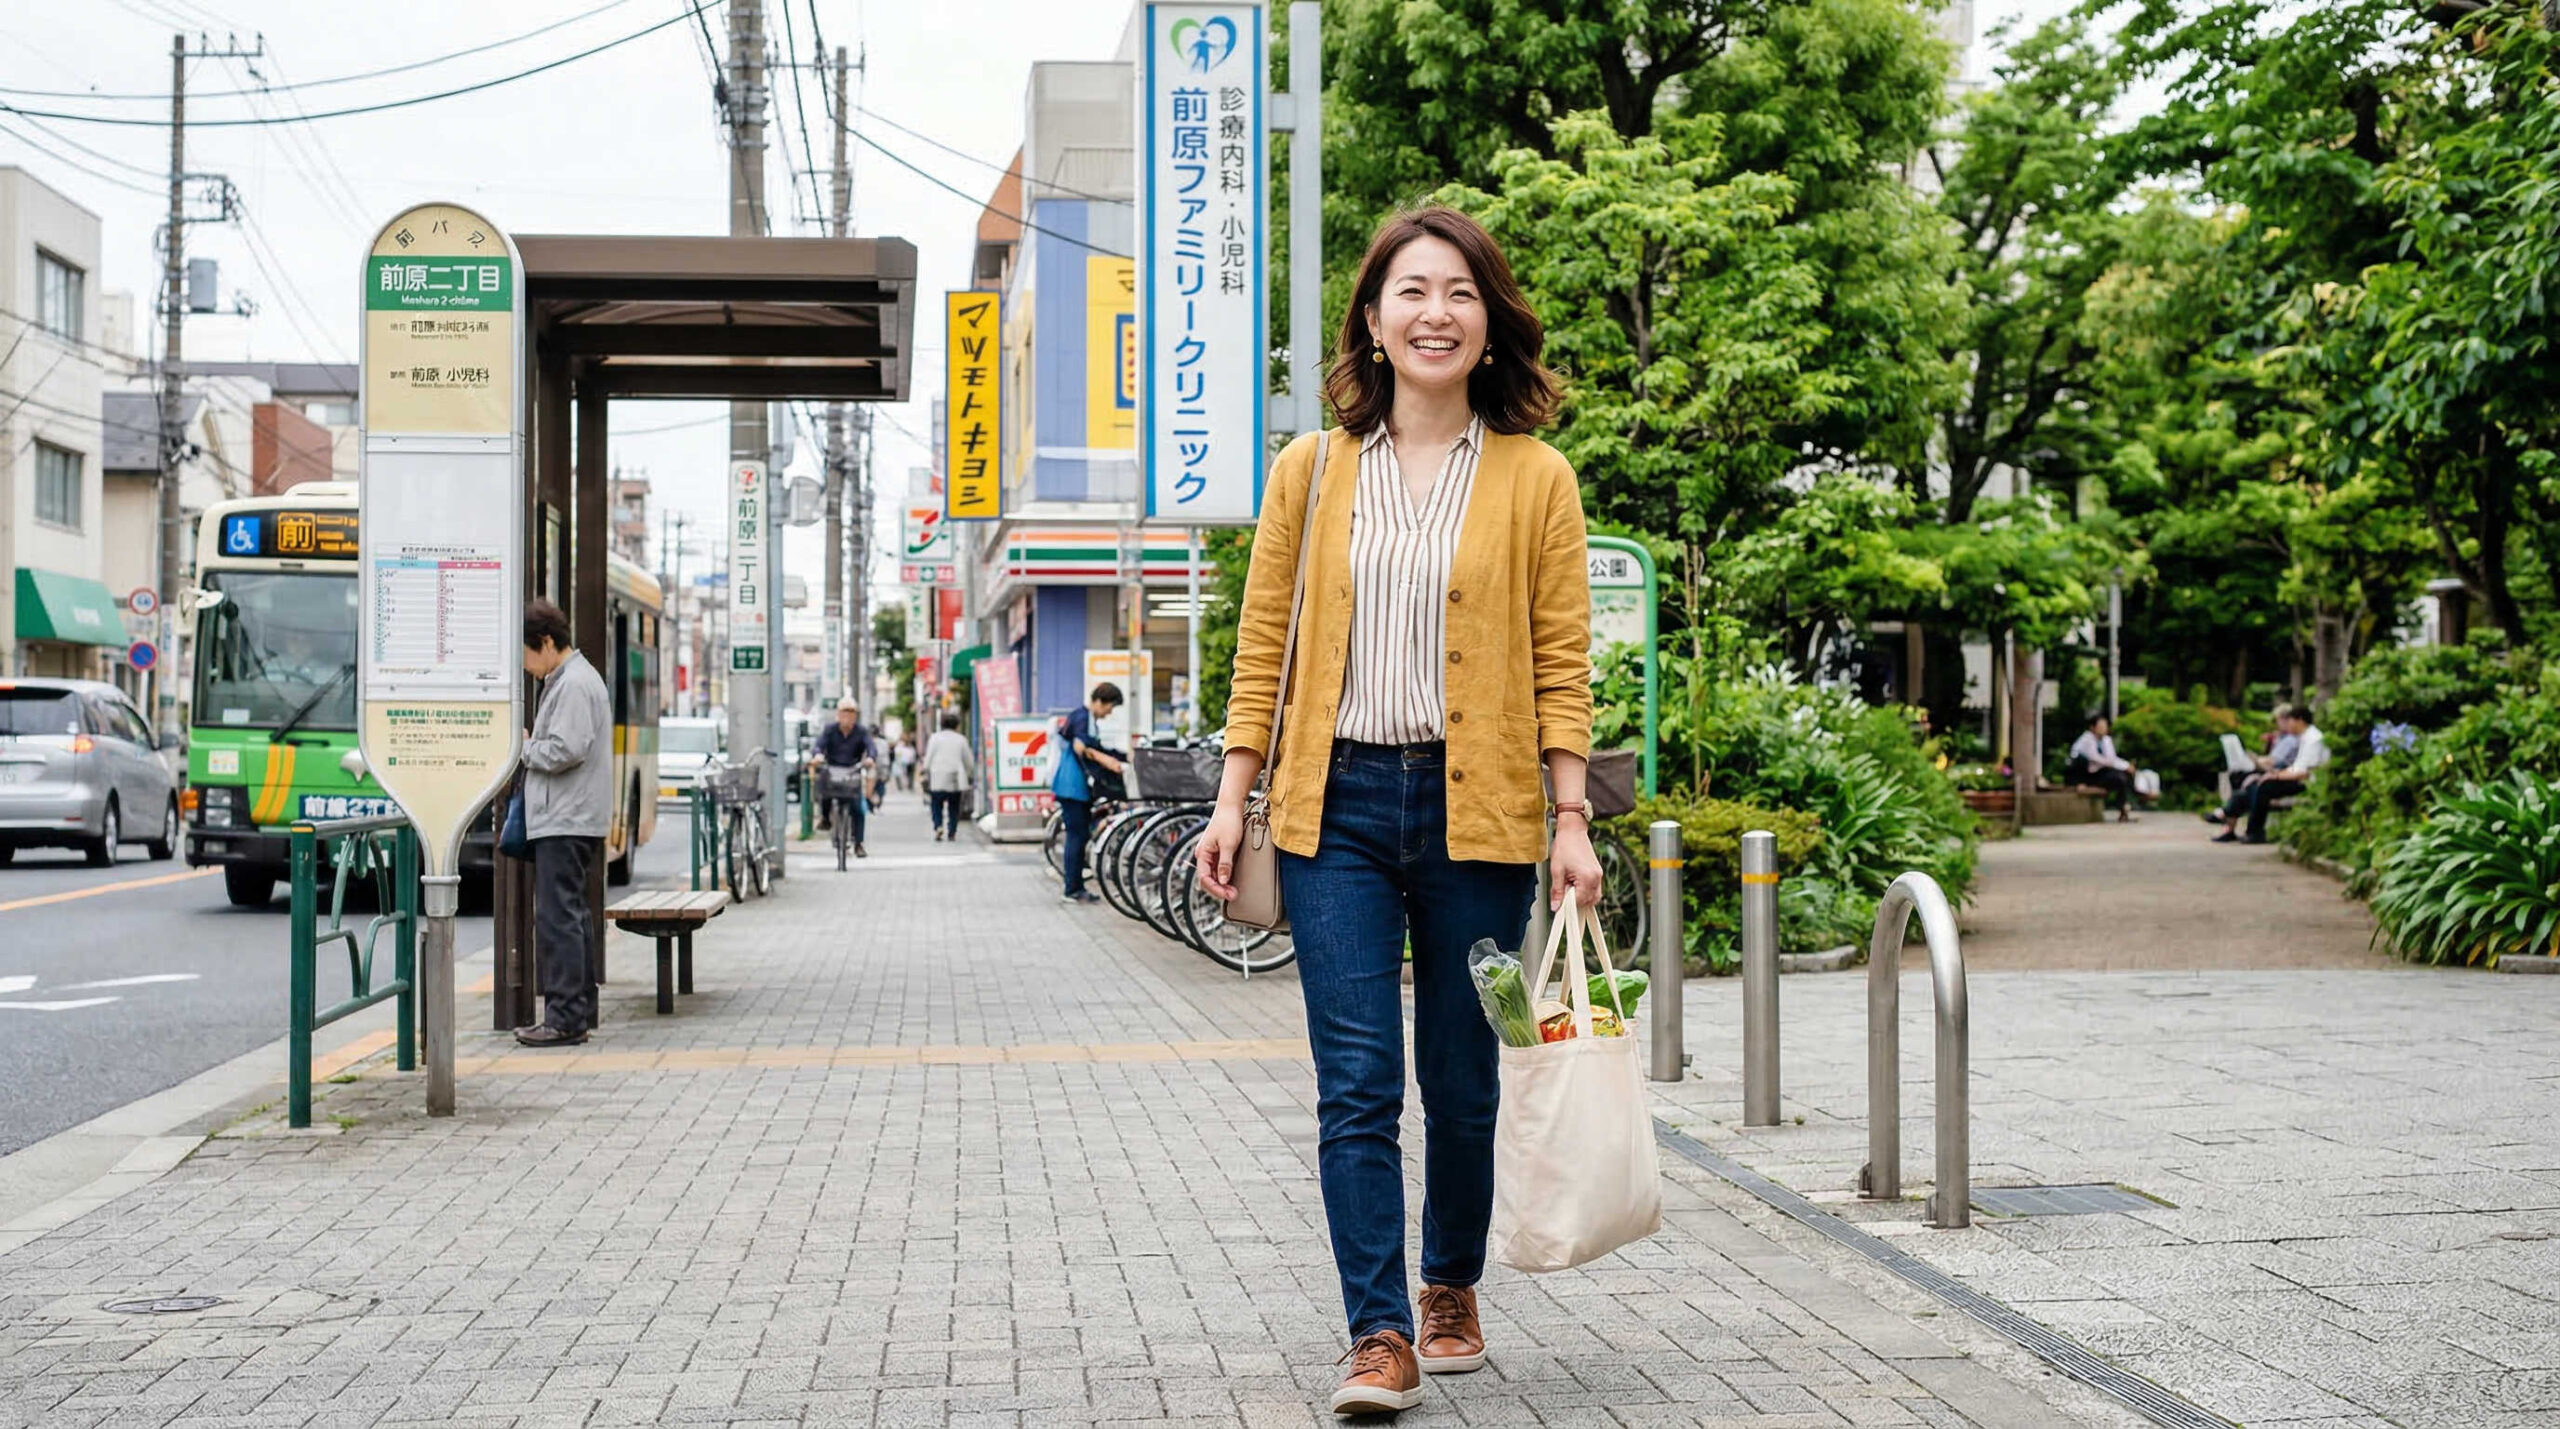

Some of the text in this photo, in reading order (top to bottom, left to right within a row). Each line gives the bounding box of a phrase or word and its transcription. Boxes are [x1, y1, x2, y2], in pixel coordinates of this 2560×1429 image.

[379, 263, 500, 292] 前原二丁目
[1171, 86, 1210, 504] 前原ファミリークリニック
[958, 300, 989, 506] マツモトキヨシ
[738, 498, 758, 605] 前原二丁目
